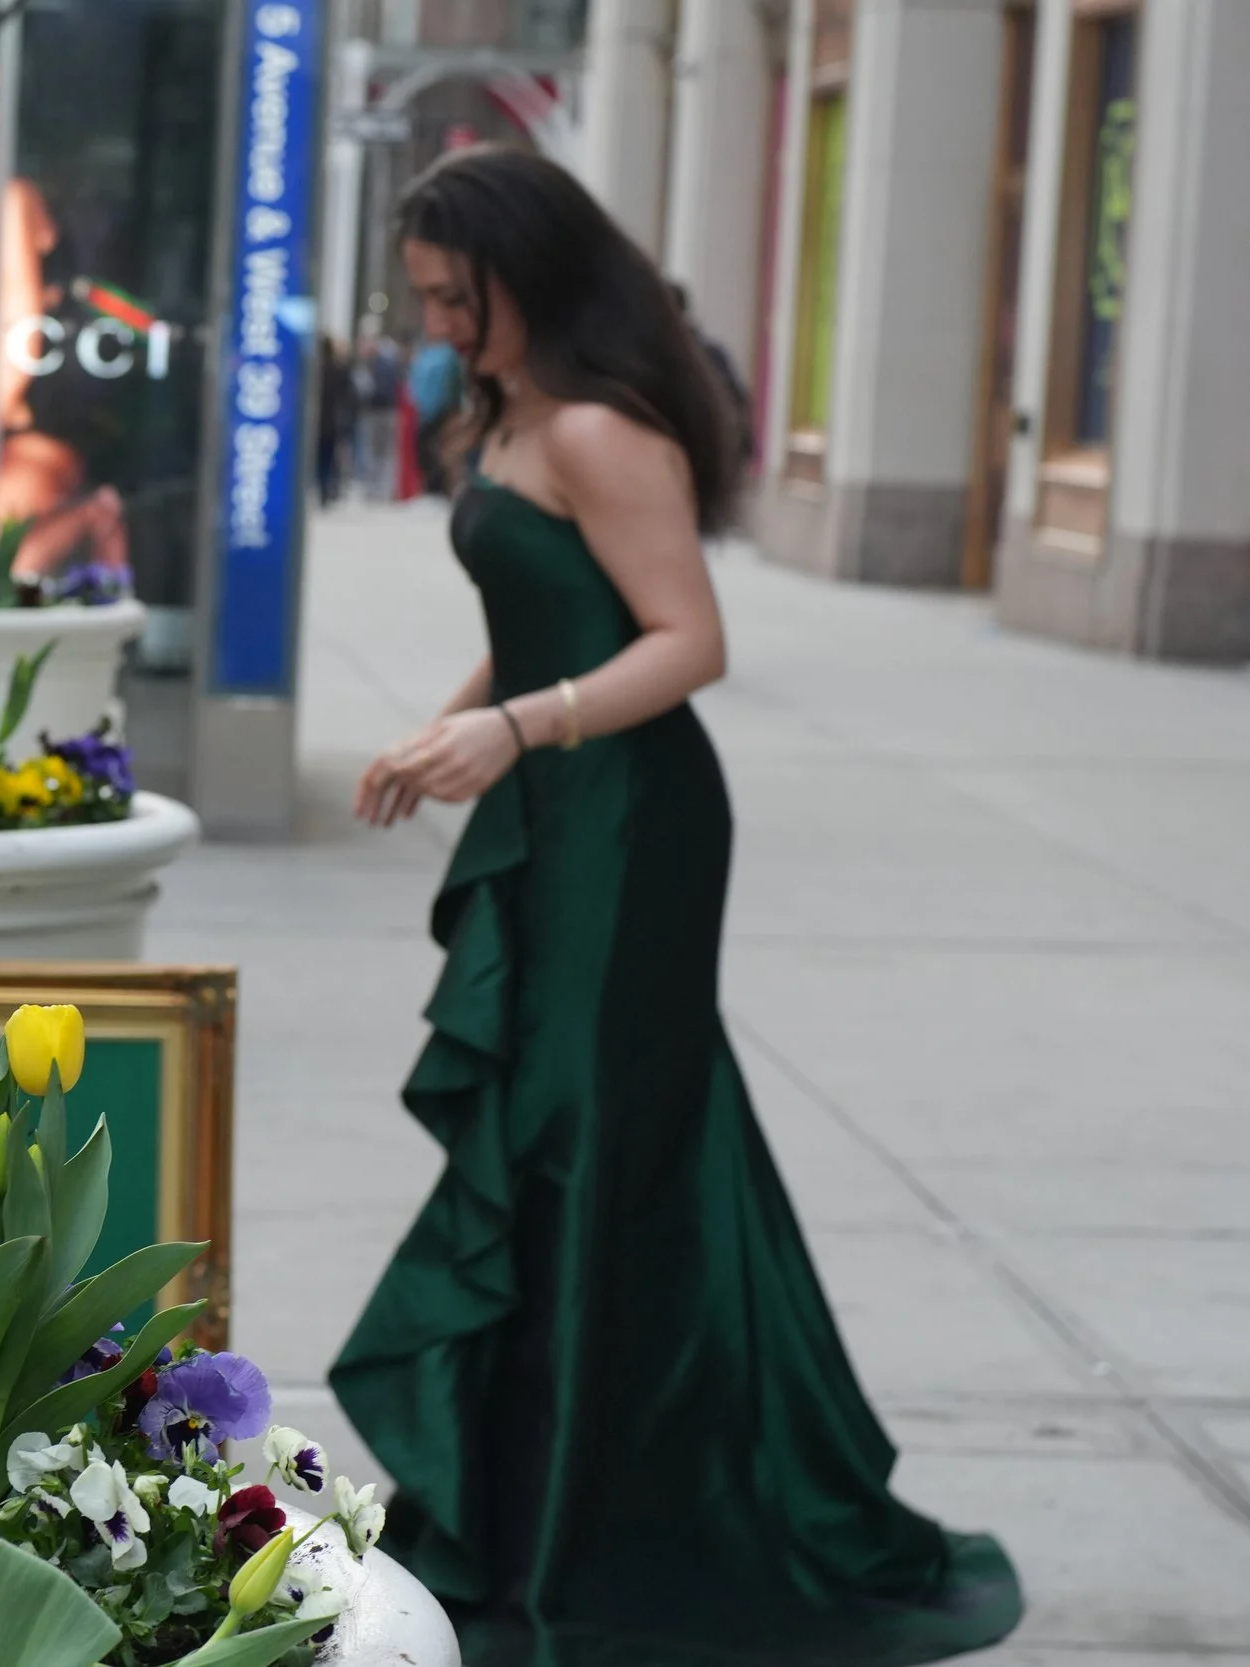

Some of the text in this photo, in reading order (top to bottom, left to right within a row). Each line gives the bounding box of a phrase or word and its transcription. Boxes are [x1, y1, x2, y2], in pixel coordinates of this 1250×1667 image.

[231, 3, 301, 548] 5 Avenue & West 39 Street
